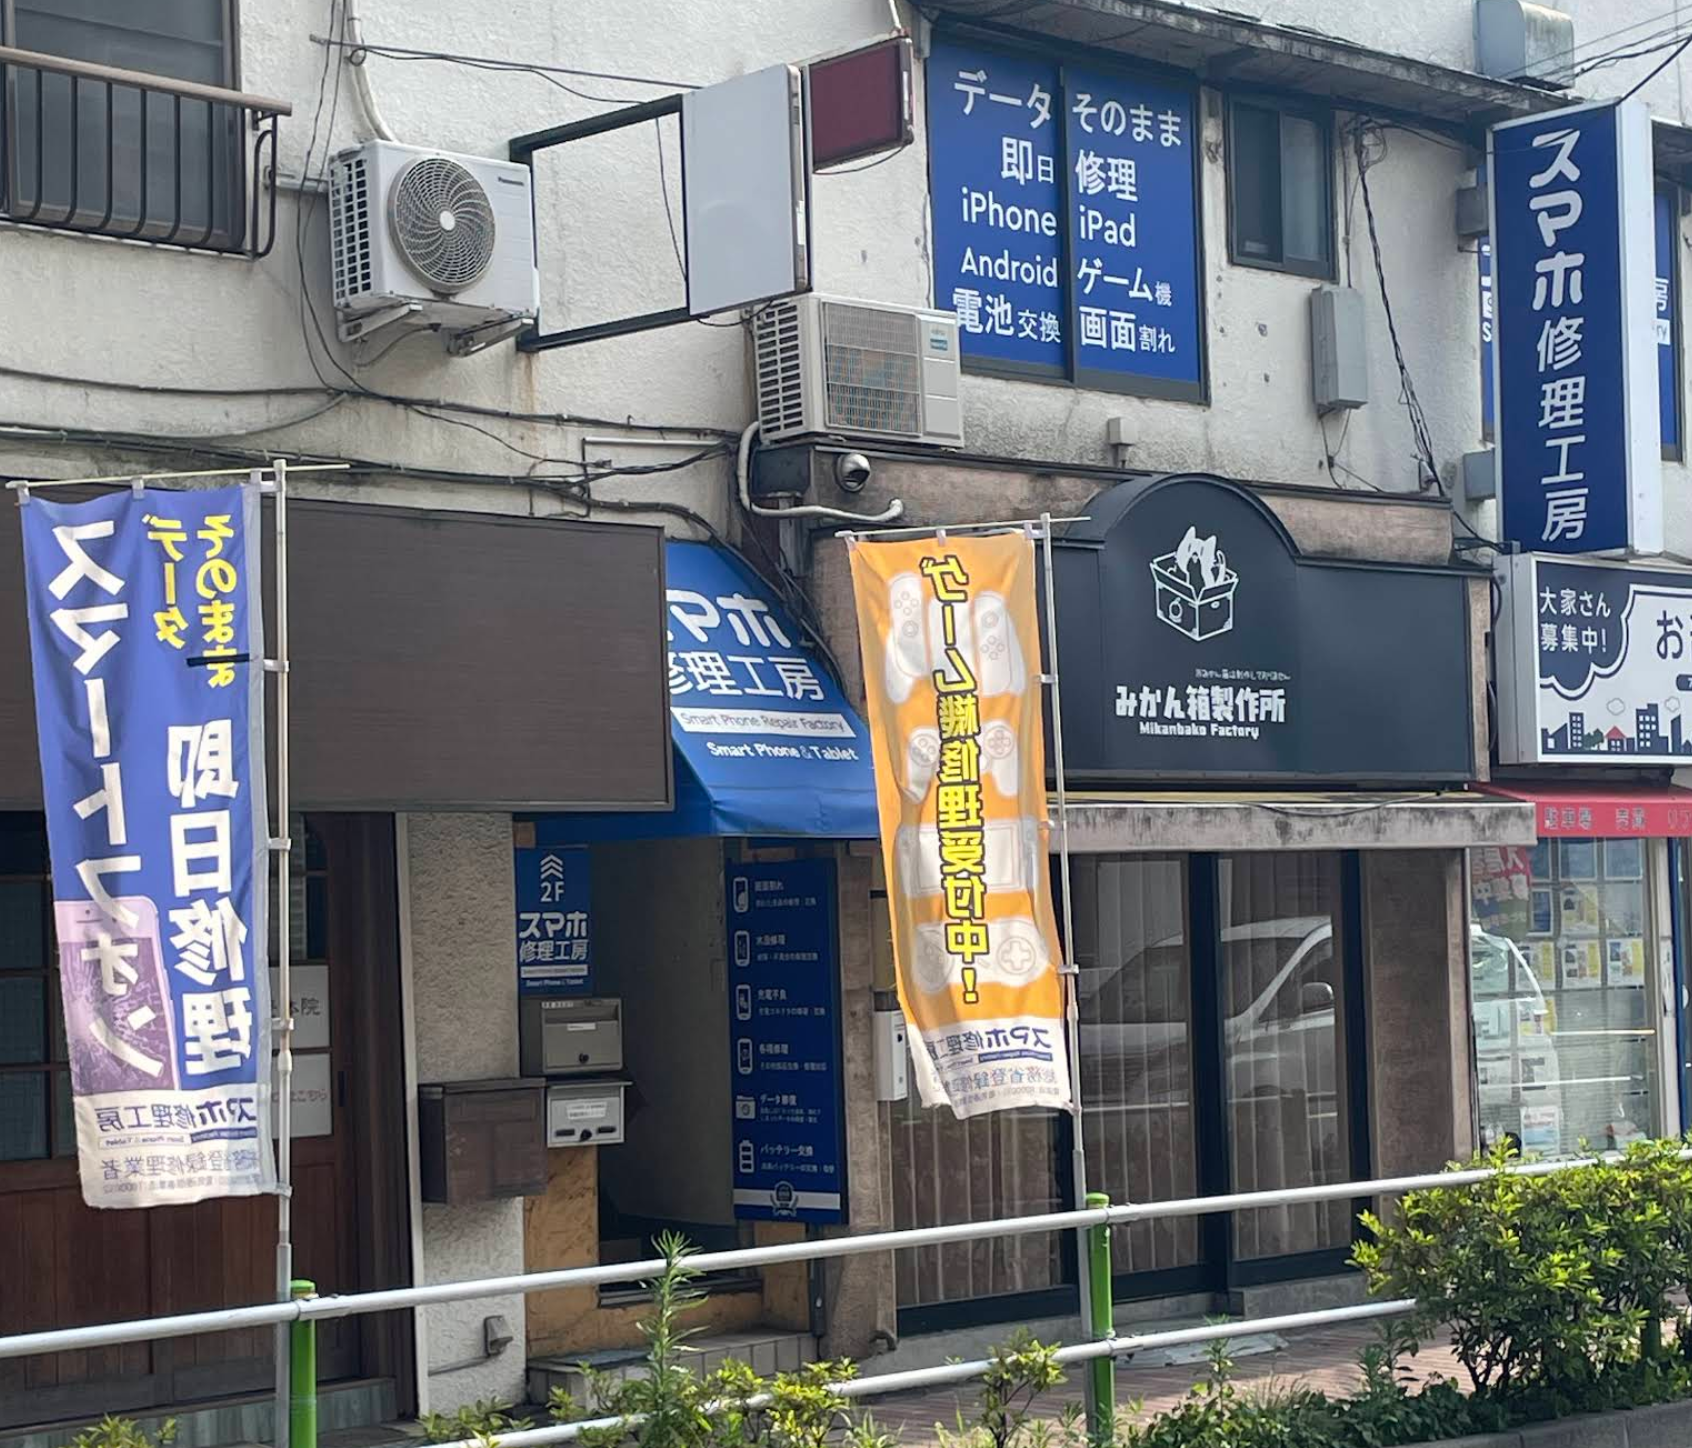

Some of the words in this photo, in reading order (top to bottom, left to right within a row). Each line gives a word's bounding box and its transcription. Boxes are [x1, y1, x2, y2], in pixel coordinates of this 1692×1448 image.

[954, 70, 1051, 129] データ
[1072, 93, 1182, 147] そのまま
[1001, 137, 1054, 185] 即日
[1075, 150, 1138, 202] 修理
[961, 187, 1057, 236] iPhone
[1079, 206, 1136, 247] iPad
[961, 247, 1058, 288] Android
[1077, 258, 1172, 306] ゲーム機
[1079, 306, 1175, 353] 画面割れ
[1529, 128, 1589, 542] スマホ修理工房
[667, 589, 792, 648] マホ
[1540, 586, 1611, 617] 大家さん
[1657, 610, 1692, 661] お
[680, 712, 719, 726] Smart
[721, 714, 760, 728] Phone
[760, 715, 799, 730] Repair
[801, 718, 845, 732] Factory
[1116, 685, 1286, 722] みかん箱製作所
[706, 741, 755, 757] Smart
[753, 743, 800, 758] Phone
[809, 746, 859, 761] Tablet
[1139, 722, 1207, 736] Mikanbako
[1210, 723, 1260, 740] Factory
[540, 881, 565, 902] 2F
[519, 911, 588, 938] スマホ
[519, 940, 589, 962] 修理工房
